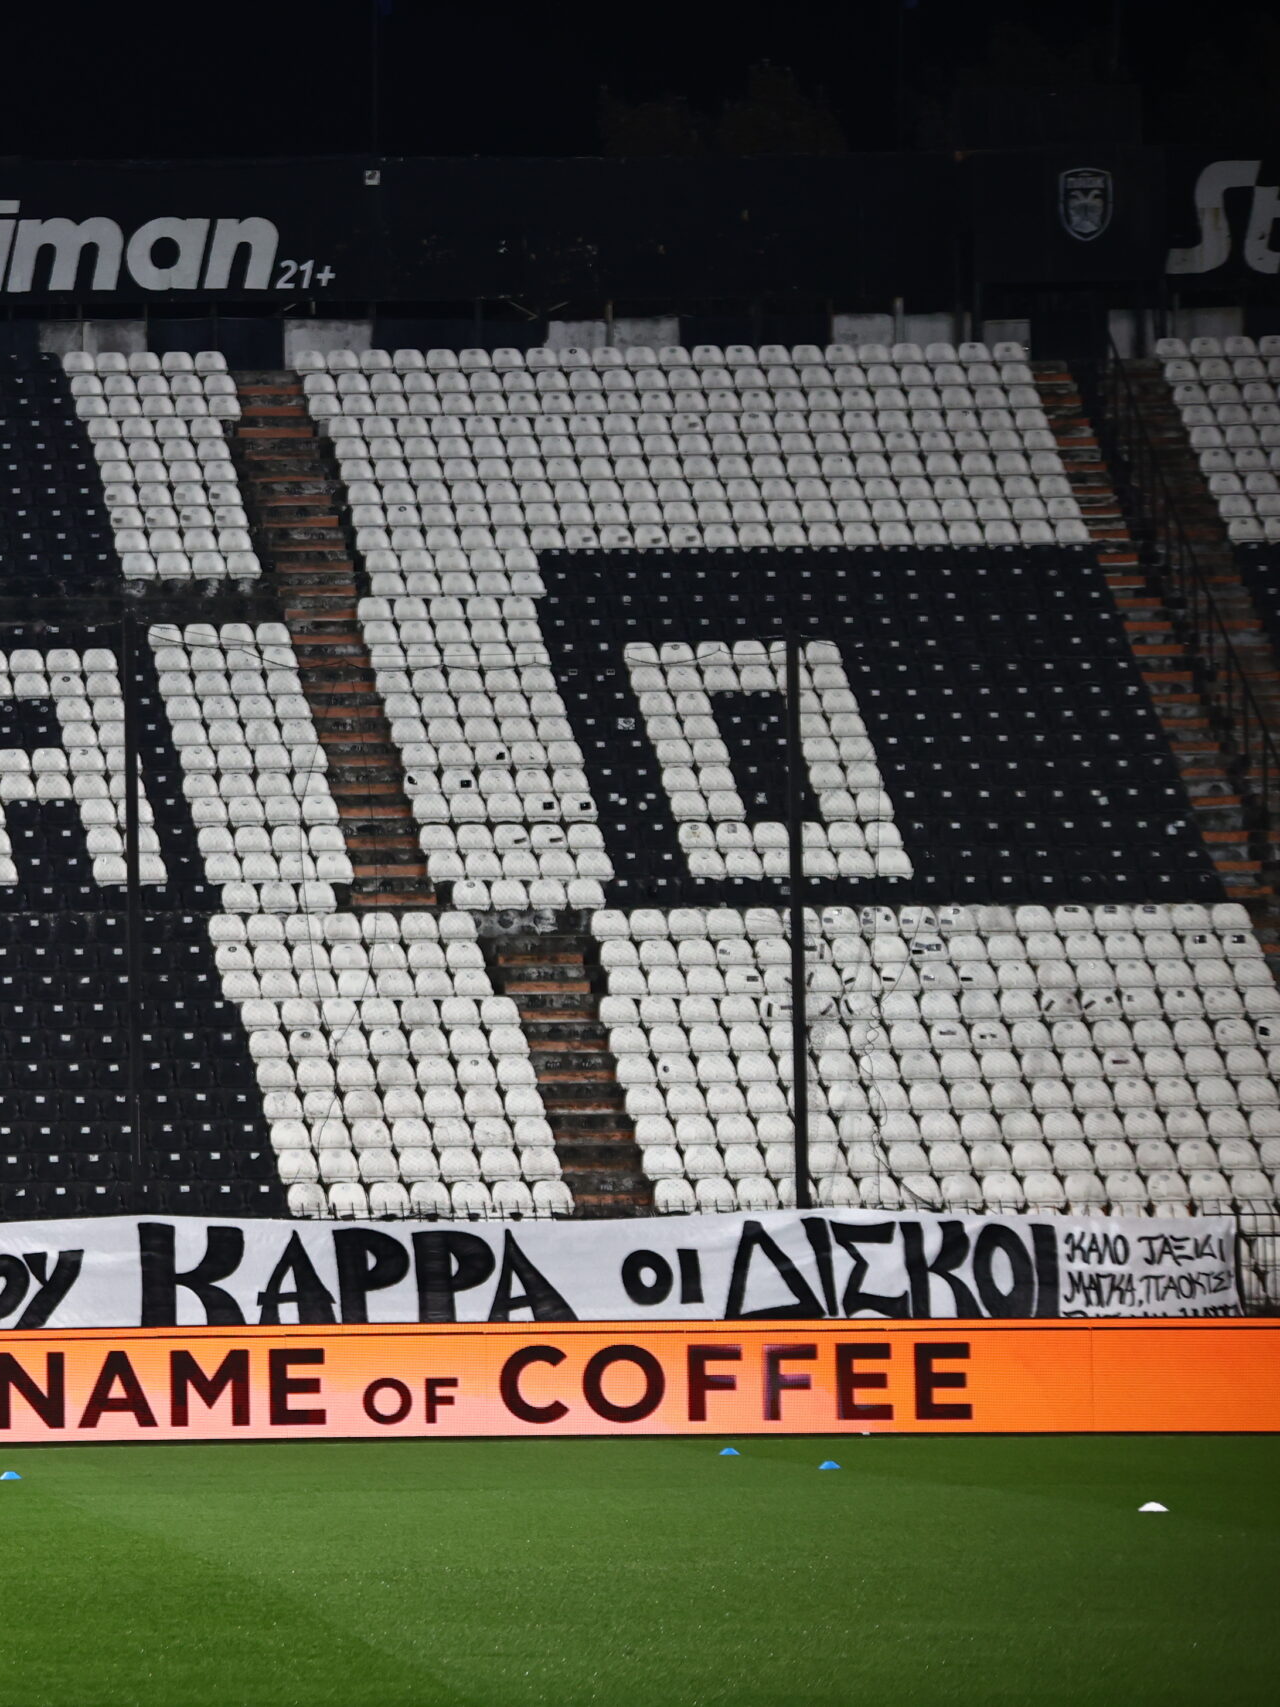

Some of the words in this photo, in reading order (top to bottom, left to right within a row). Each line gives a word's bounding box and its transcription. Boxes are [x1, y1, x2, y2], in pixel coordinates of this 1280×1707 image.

[275, 259, 336, 290] 21+
[137, 1222, 580, 1326] ΚΑΡΡΑ
[621, 1248, 705, 1306] ΟΙ
[723, 1217, 1061, 1319] ΔΙΣΚΟΙ
[1064, 1231, 1130, 1266] ΚΑΛΟ
[362, 1376, 458, 1426] OF
[499, 1341, 973, 1424] COFFEE
